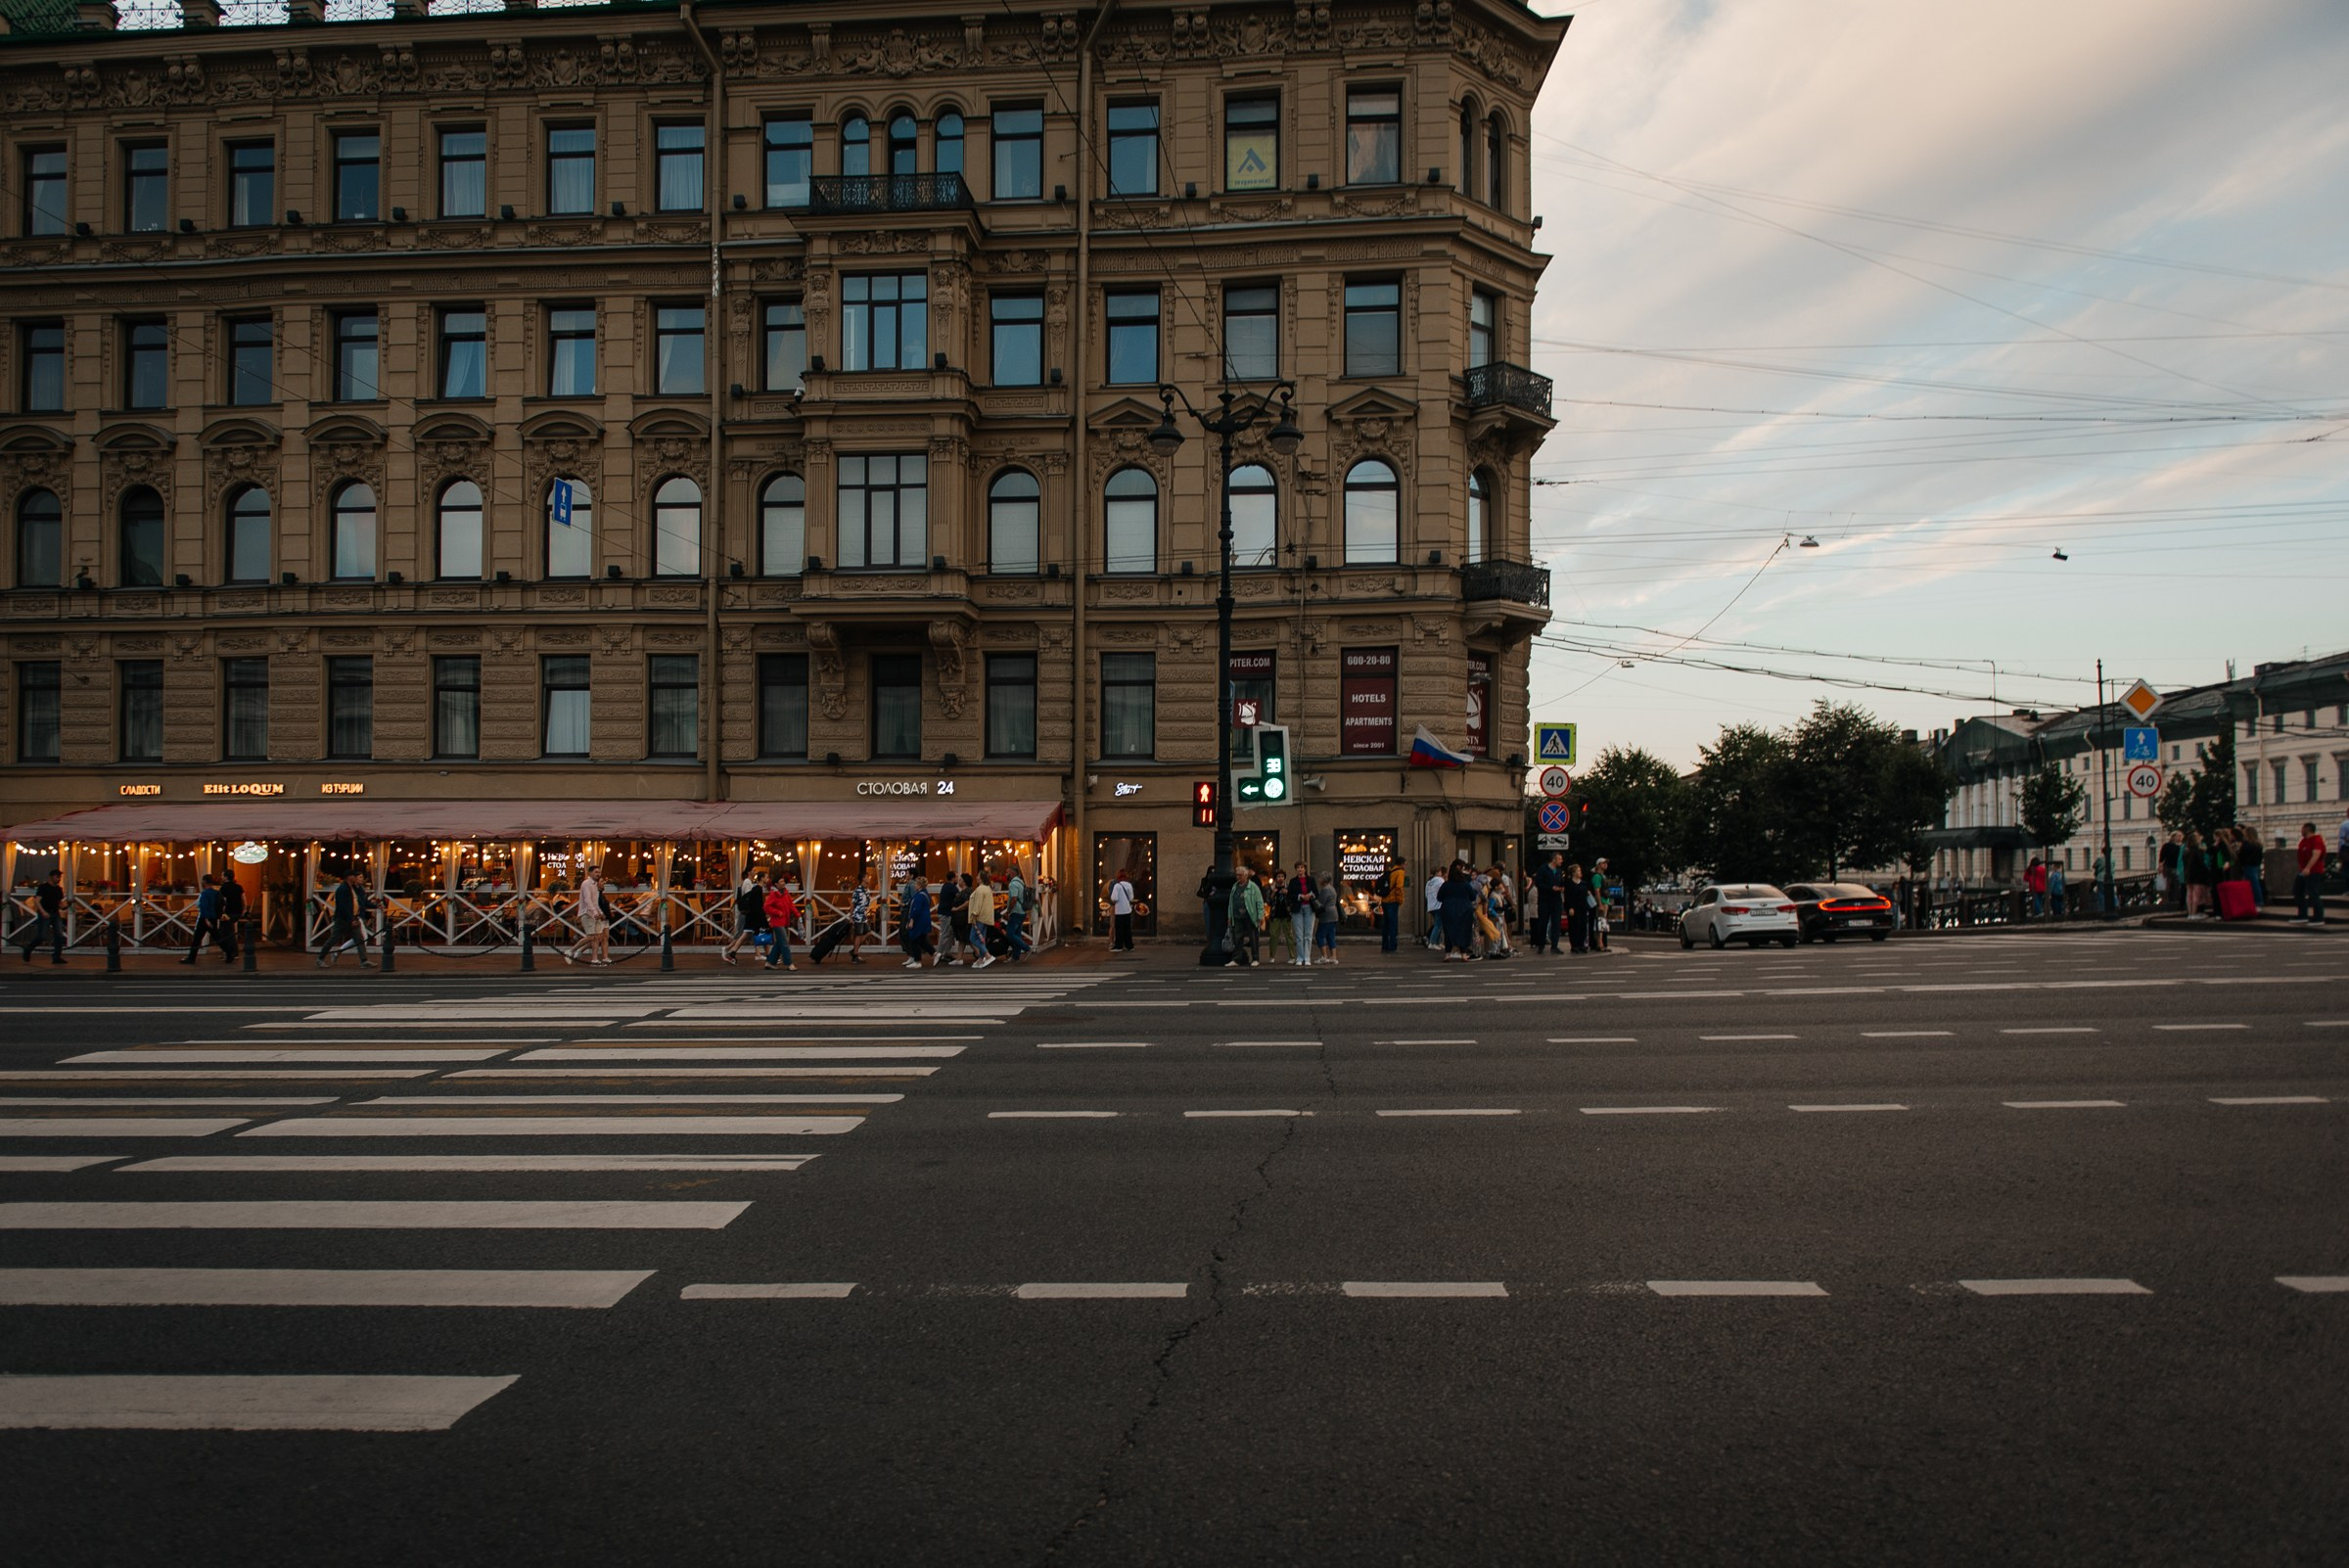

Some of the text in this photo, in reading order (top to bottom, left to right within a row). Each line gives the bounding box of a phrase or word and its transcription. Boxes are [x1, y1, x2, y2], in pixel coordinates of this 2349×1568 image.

[1347, 655, 1391, 666] 600-20-80
[1352, 693, 1386, 703] HOTELS
[1345, 716, 1393, 726] APARTMENTS
[1546, 776, 1563, 788] 40
[2136, 774, 2154, 788] 40
[120, 785, 161, 795] СЛАДОСТИ
[204, 783, 284, 796] Elit LOQUM
[321, 783, 364, 794] ИЗ ТУРЦИИ
[856, 780, 954, 795] СТОЛОВАЯ 24
[1343, 854, 1385, 863] НЕВСКАЯ
